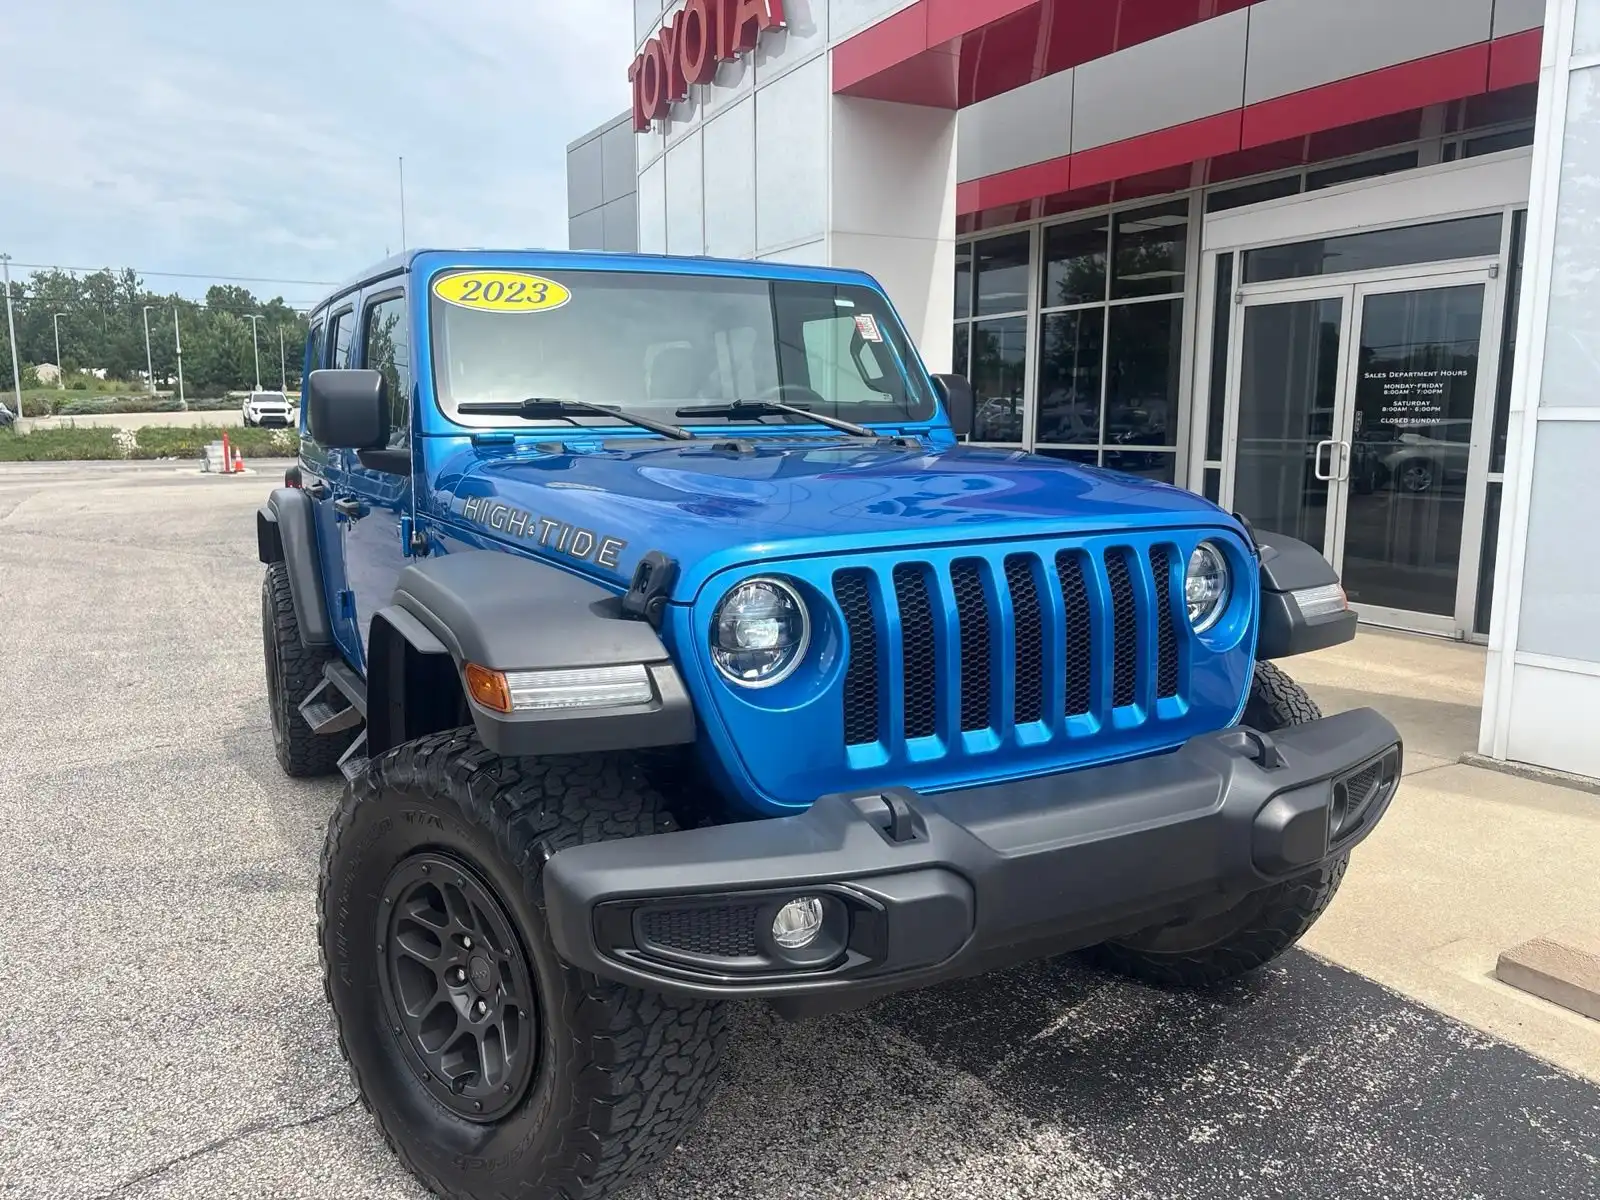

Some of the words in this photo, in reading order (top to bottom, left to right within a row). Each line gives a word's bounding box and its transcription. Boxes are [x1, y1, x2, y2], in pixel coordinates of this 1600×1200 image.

[459, 280, 549, 304] 2023
[462, 495, 529, 538] HIGH
[539, 515, 628, 569] TIDE
